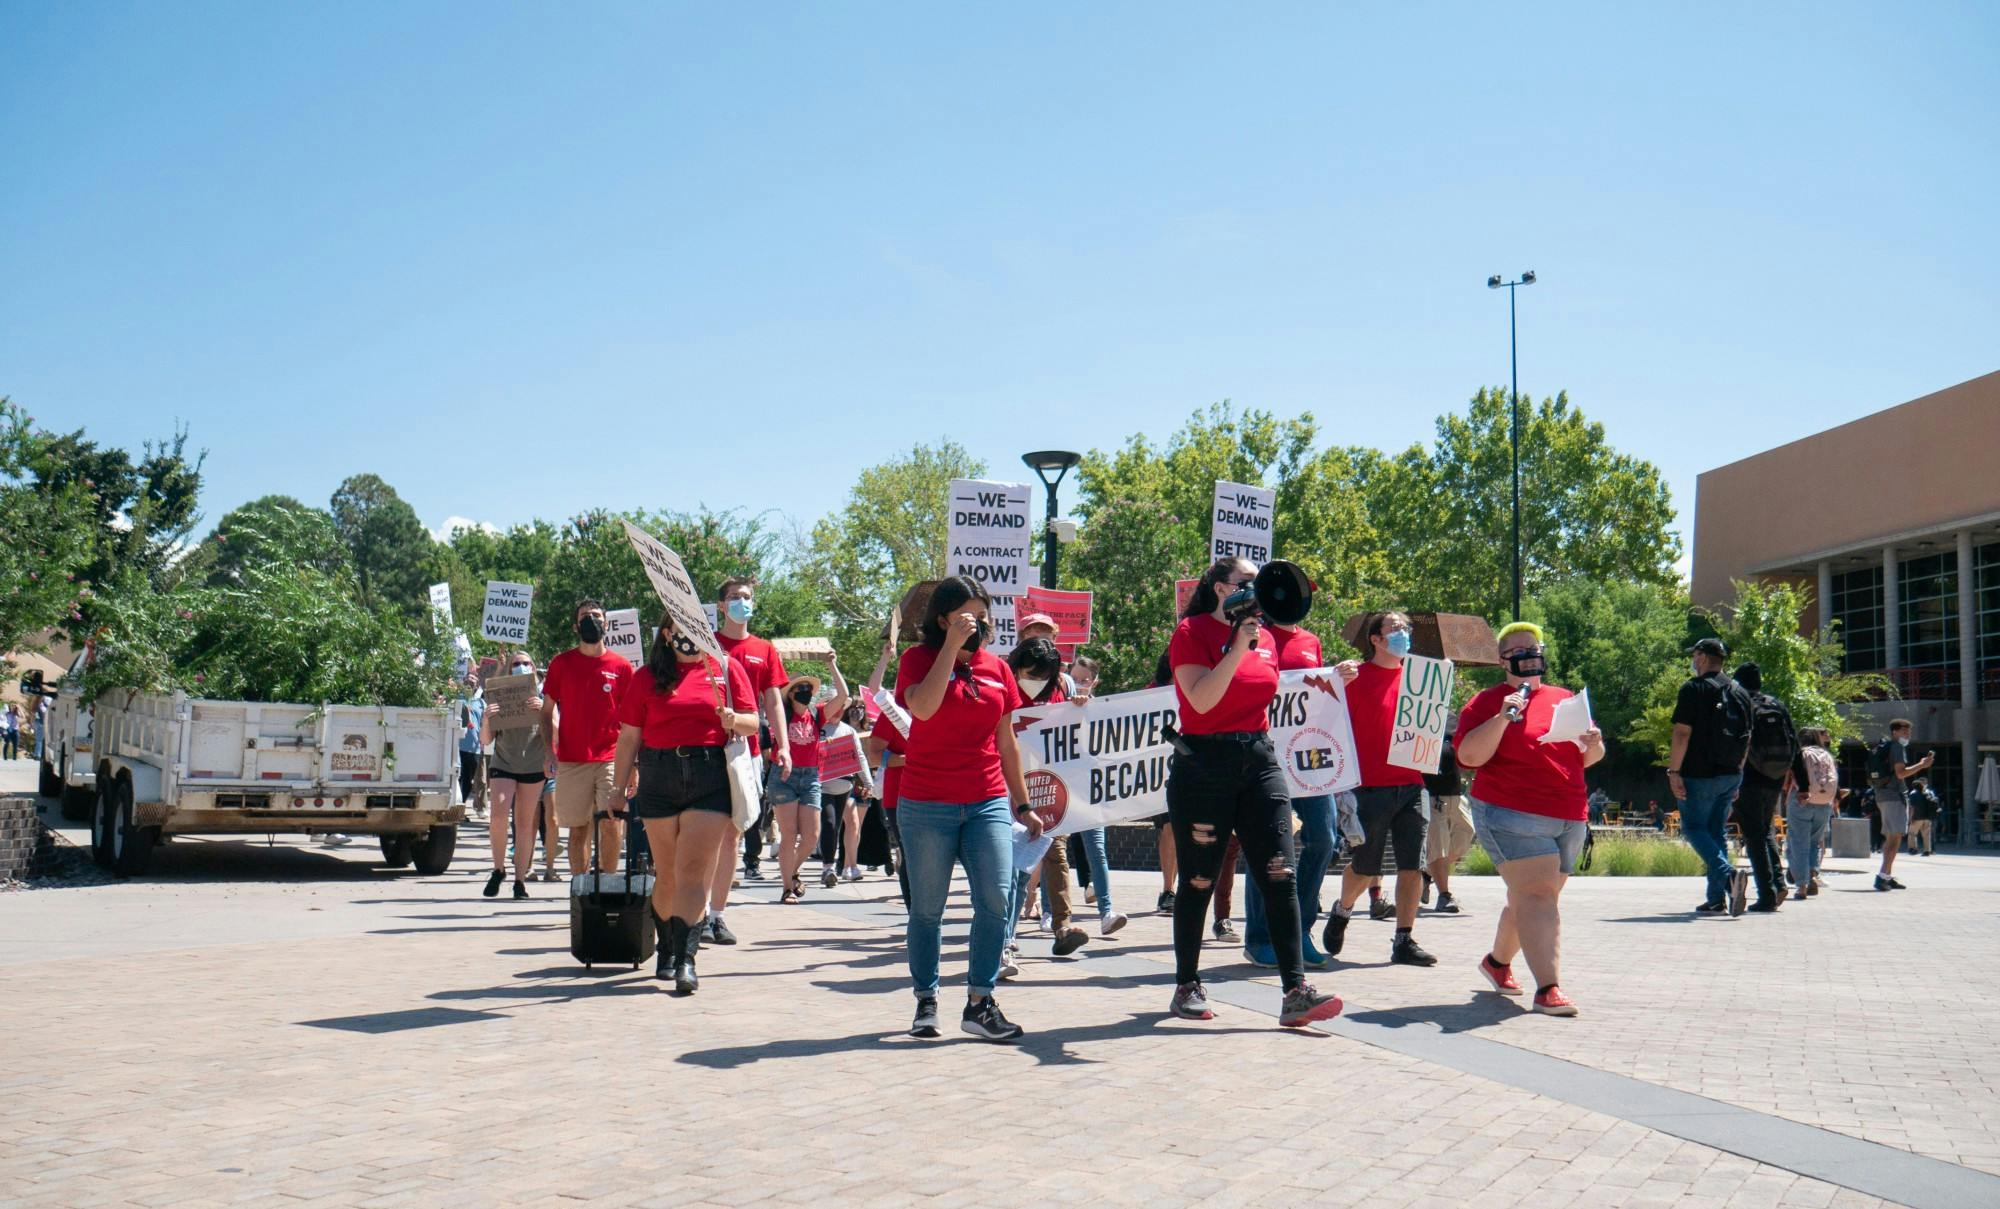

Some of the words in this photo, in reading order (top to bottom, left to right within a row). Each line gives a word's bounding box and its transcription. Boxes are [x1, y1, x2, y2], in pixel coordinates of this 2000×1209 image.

[978, 492, 1006, 508] WE
[1236, 493, 1257, 510] WE
[956, 512, 1025, 528] DEMAND
[1217, 509, 1268, 530] DEMAND
[644, 540, 669, 567] WE
[954, 546, 962, 556] A
[965, 547, 1024, 558] CONTRACT
[1215, 539, 1267, 562] BETTER
[640, 551, 692, 596] DEMAND
[959, 564, 1017, 584] NOW!
[501, 588, 518, 598] WE
[488, 598, 528, 609] DEMAND
[660, 591, 709, 634] ADEQUATE
[486, 614, 493, 622] A
[496, 616, 526, 625] LIVING
[667, 606, 716, 650] BENEFITS
[486, 625, 524, 638] WAGE
[1406, 657, 1453, 702] UN
[1397, 695, 1450, 734] BUS
[1040, 723, 1081, 764] THE
[1088, 709, 1177, 756] UNIVER
[1316, 728, 1344, 753] EVERYONE
[1394, 729, 1415, 746] is
[1029, 784, 1058, 798] ADUATE
